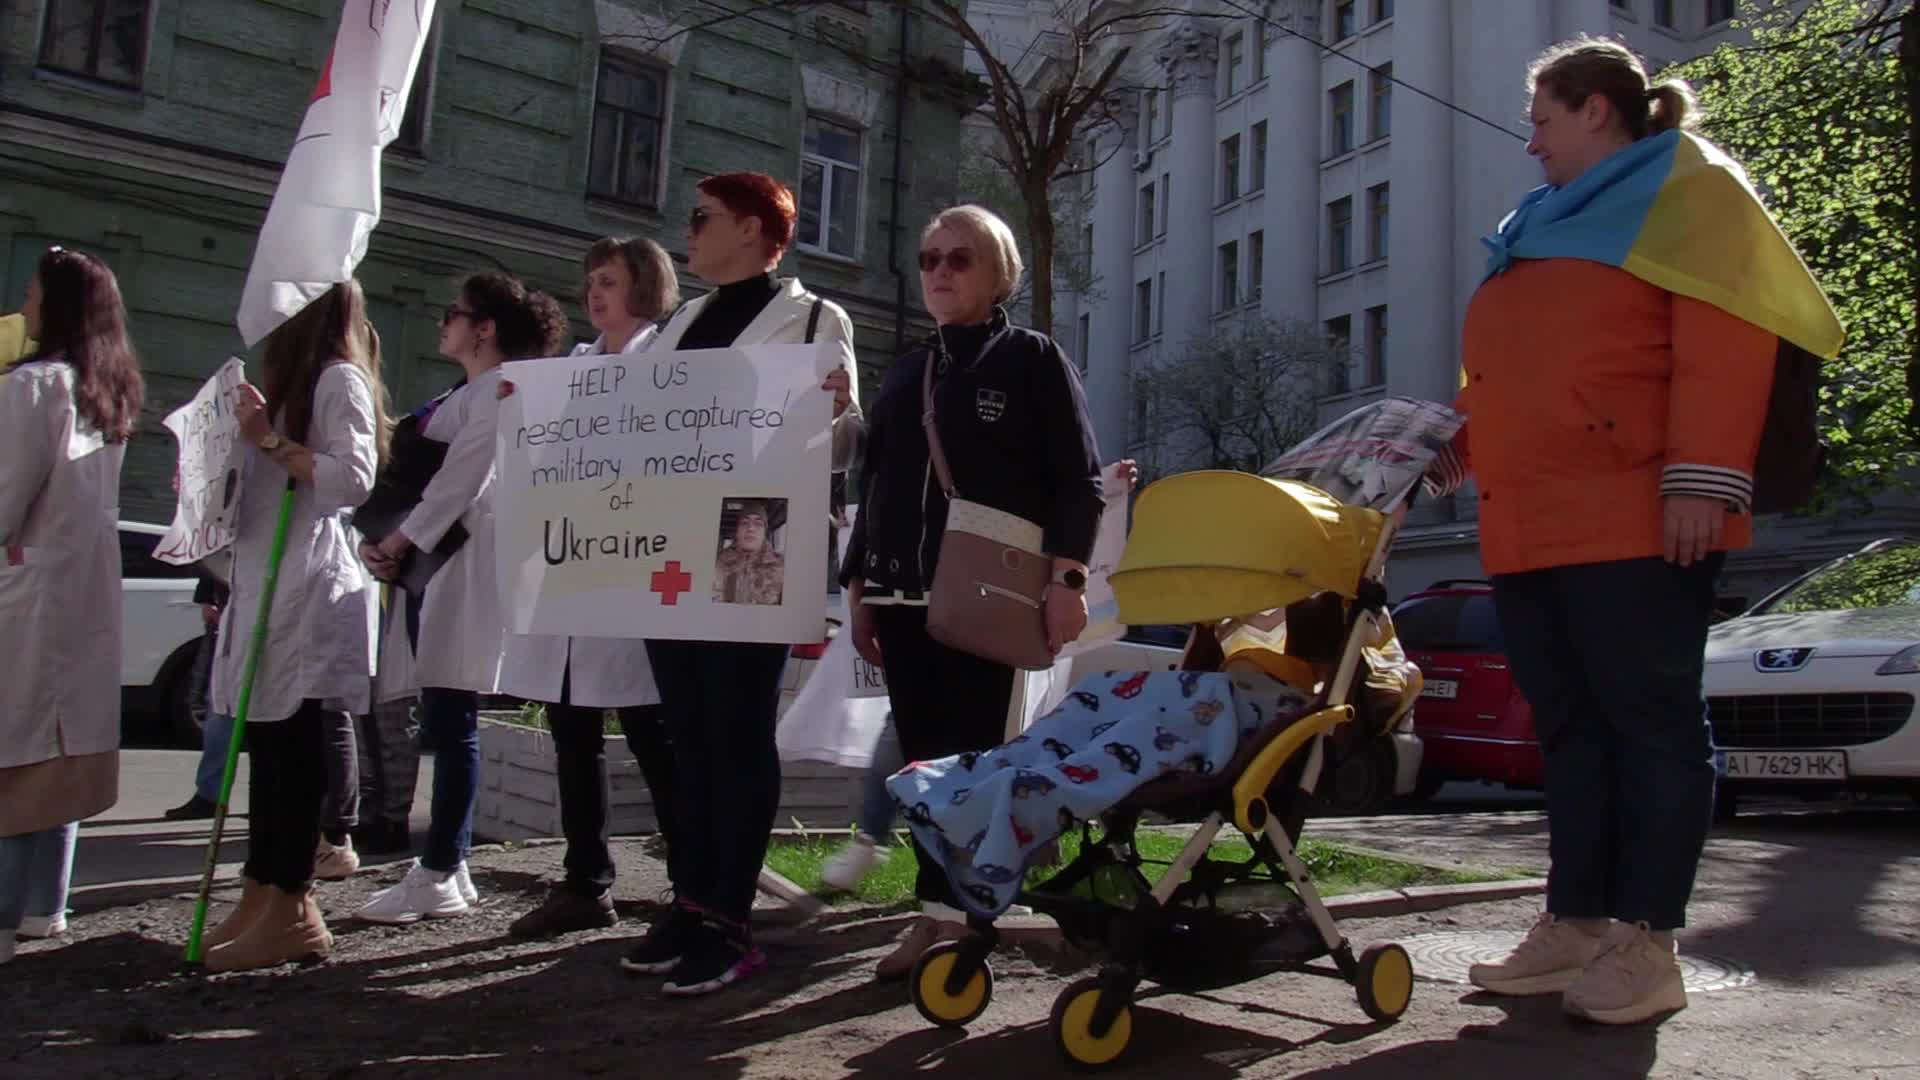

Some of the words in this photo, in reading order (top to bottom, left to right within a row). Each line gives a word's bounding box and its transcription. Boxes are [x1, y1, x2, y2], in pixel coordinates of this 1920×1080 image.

[568, 365, 627, 400] HELP
[653, 361, 689, 390] US
[516, 412, 611, 448] rescue
[617, 402, 658, 435] the
[664, 389, 791, 441] captured
[532, 447, 622, 492] military
[644, 444, 735, 477] medics
[609, 482, 634, 511] of
[543, 517, 668, 565] Ukraine
[1756, 755, 1801, 775] 7629
